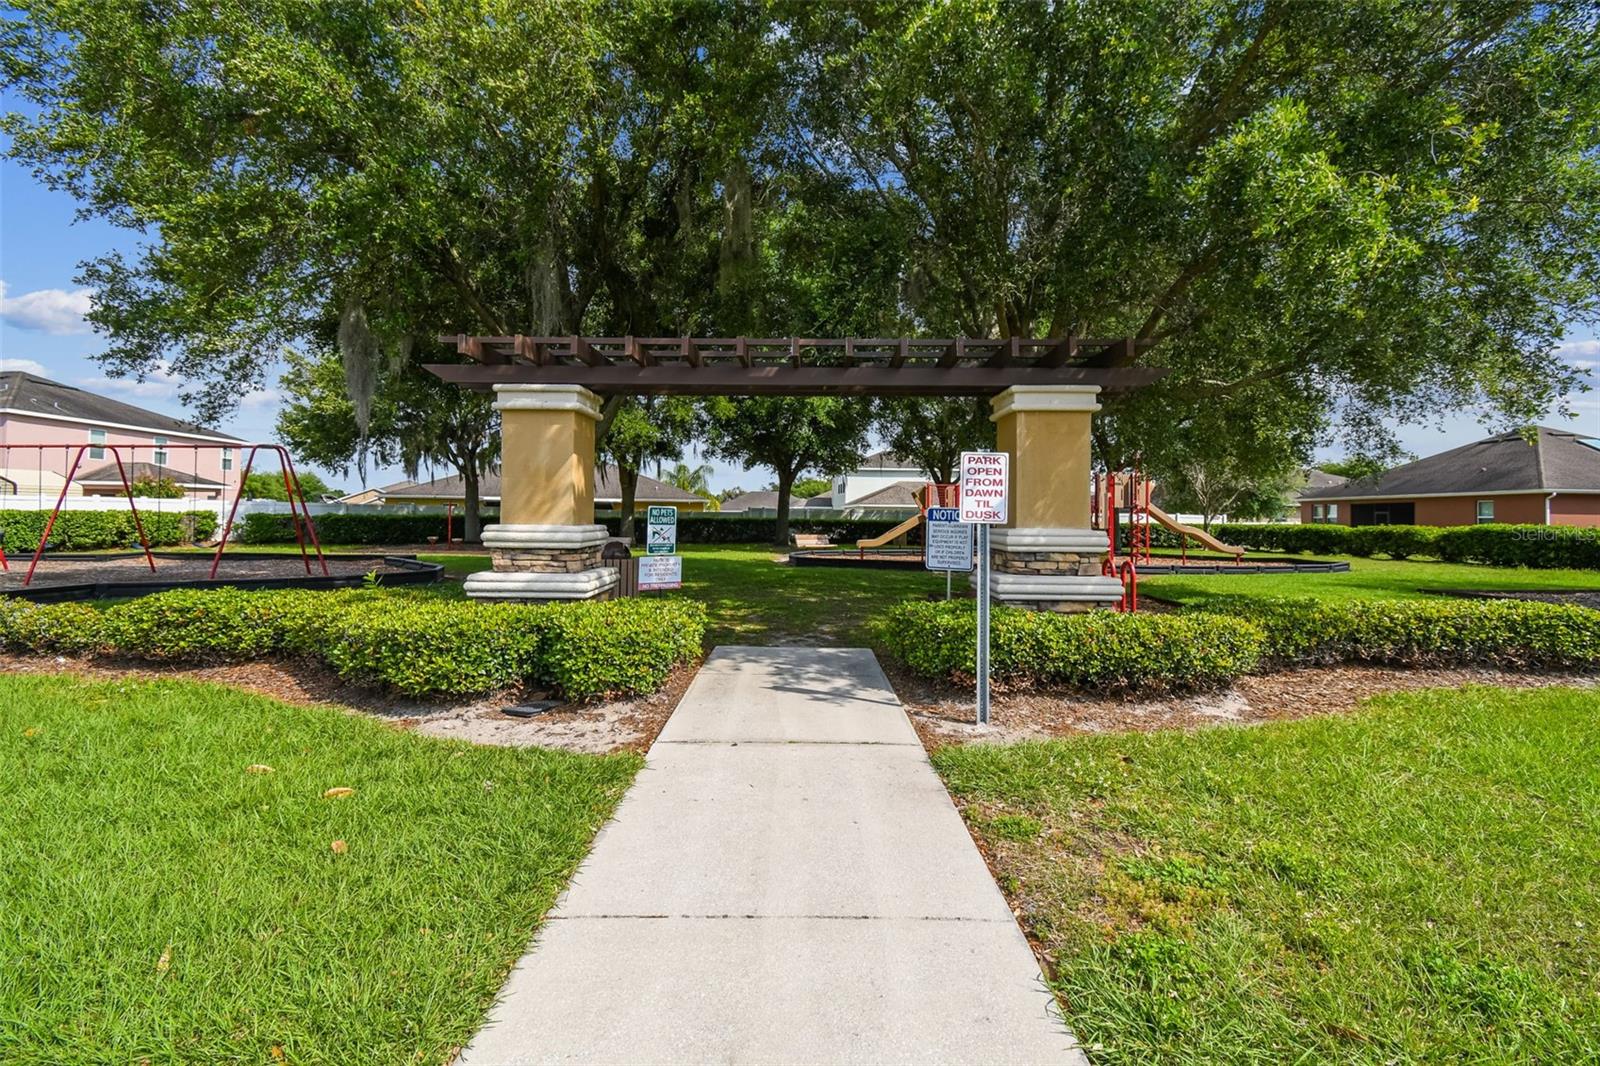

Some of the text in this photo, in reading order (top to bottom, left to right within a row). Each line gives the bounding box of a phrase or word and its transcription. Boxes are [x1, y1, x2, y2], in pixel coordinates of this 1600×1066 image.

[968, 456, 1001, 464] PARK
[967, 467, 1002, 476] OPEN
[966, 478, 1003, 486] FROM
[966, 489, 1003, 497] DAWN
[975, 500, 993, 508] TIL
[932, 510, 960, 520] NOTIC
[966, 511, 1001, 519] DUSK
